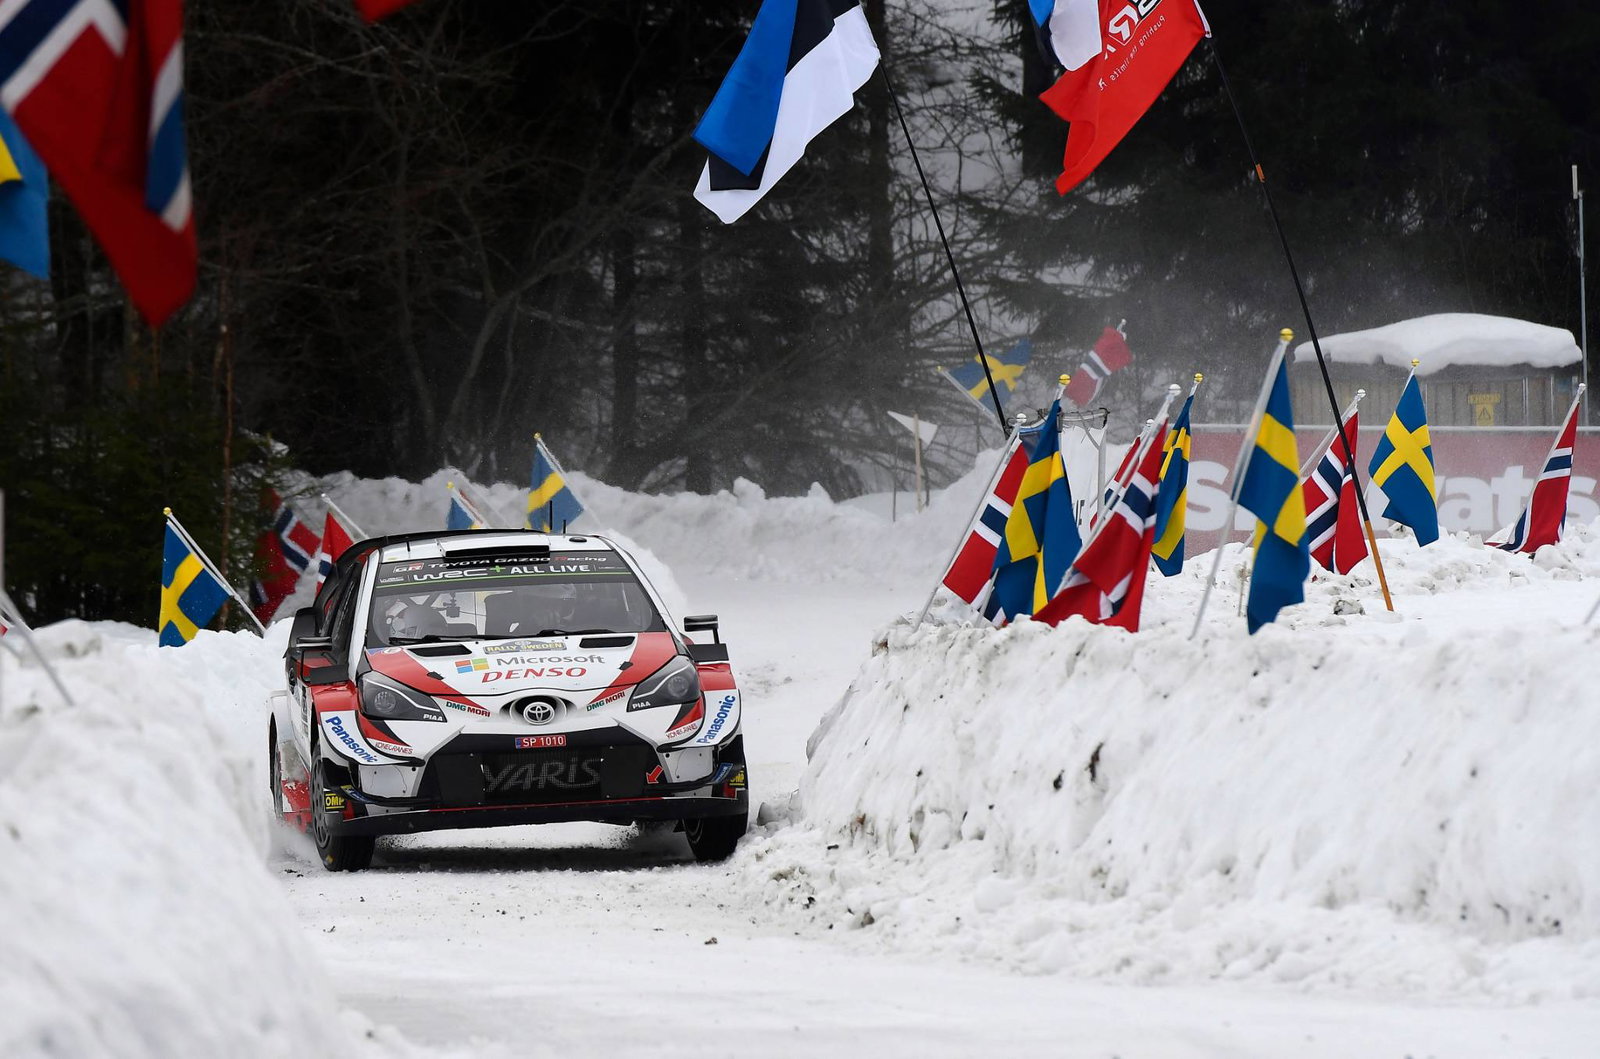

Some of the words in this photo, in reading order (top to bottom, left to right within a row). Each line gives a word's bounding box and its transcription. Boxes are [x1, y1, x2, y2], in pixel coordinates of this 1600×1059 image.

[428, 558, 490, 568] TOYOTA
[495, 556, 551, 564] GAZOO
[511, 564, 545, 575] ALL
[551, 563, 591, 573] LIVE
[486, 645, 518, 654] RALLY
[521, 642, 564, 652] SWEDEN
[496, 653, 606, 666] Microsoft
[481, 667, 587, 683] DENSO
[586, 700, 605, 712] DMG
[605, 691, 626, 704] MORI
[632, 701, 651, 710] PIAA
[446, 701, 466, 712] DMG
[467, 706, 490, 717] MORI
[423, 713, 443, 722] PIAA
[696, 695, 736, 744] Panasonic
[325, 716, 378, 763] Panasonic
[522, 738, 537, 747] SP
[540, 736, 564, 746] 1010
